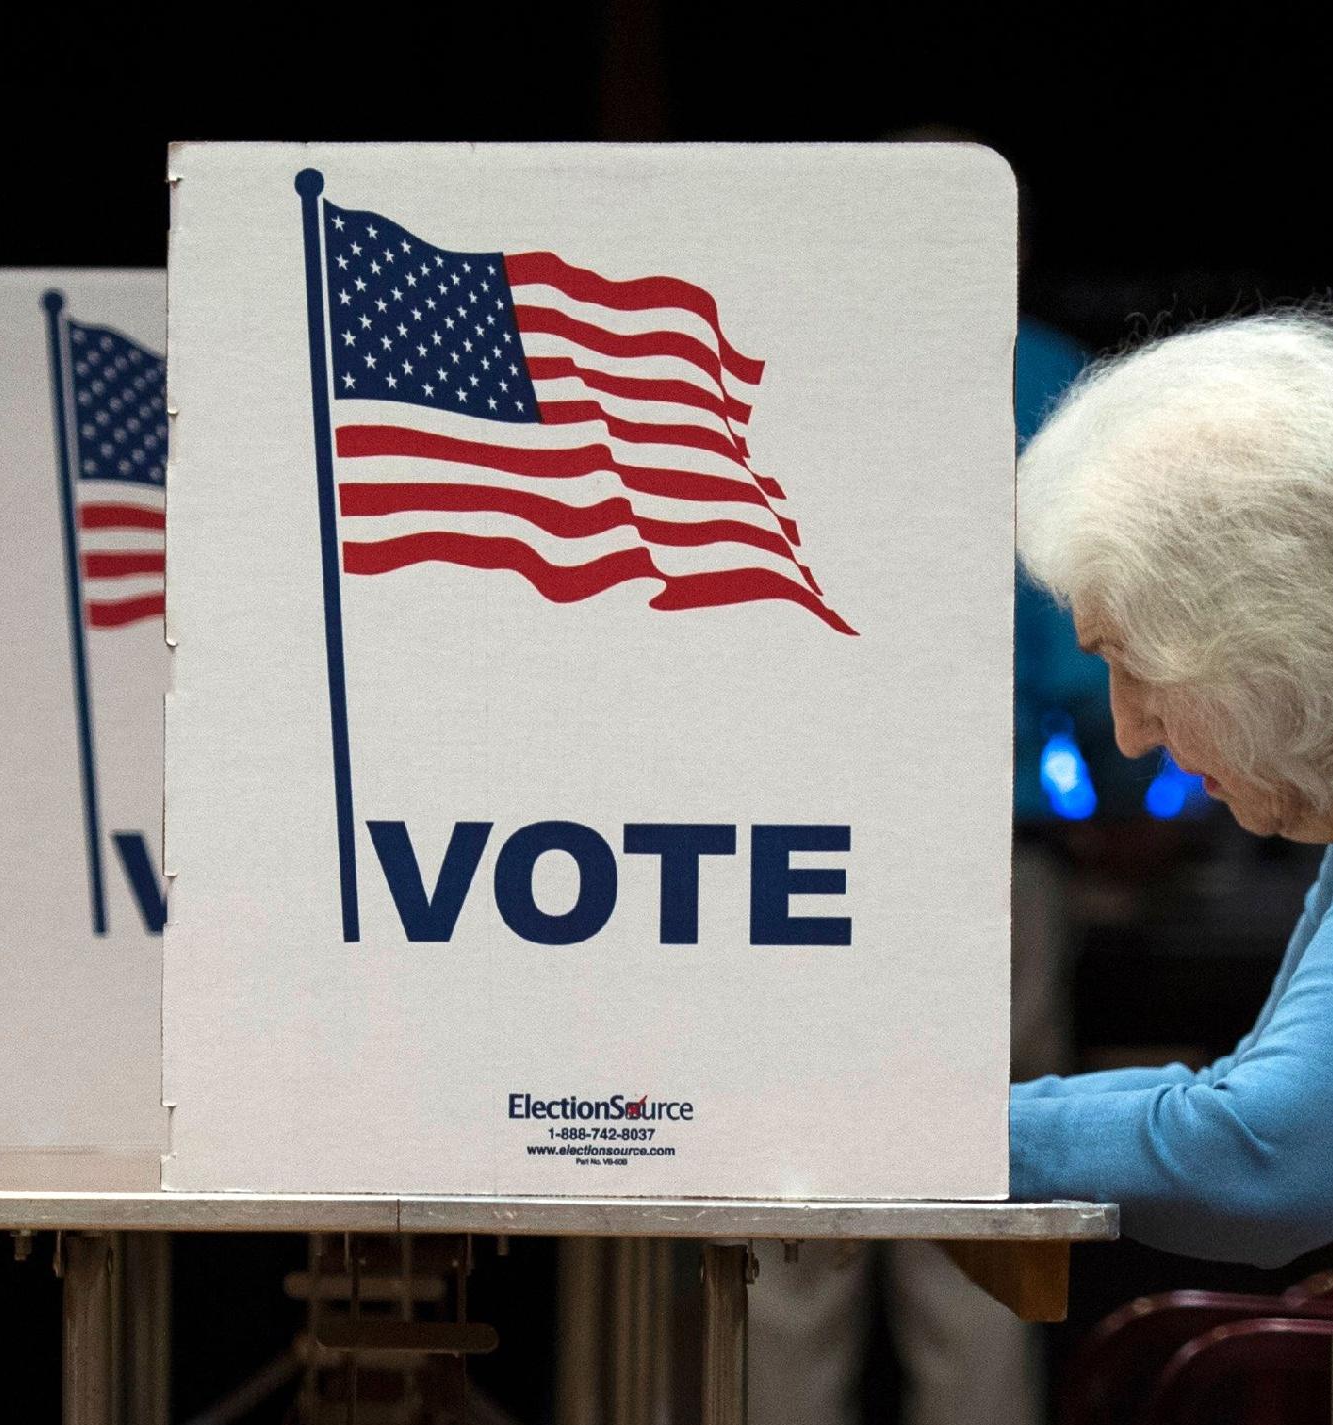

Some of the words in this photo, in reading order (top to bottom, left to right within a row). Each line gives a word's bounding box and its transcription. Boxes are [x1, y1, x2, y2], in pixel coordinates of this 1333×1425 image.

[365, 820, 853, 947] VOTE
[508, 1093, 694, 1121] ElectionSource
[548, 1127, 656, 1142] 1-888-742-8037
[526, 1144, 676, 1157] www.electionsource.com
